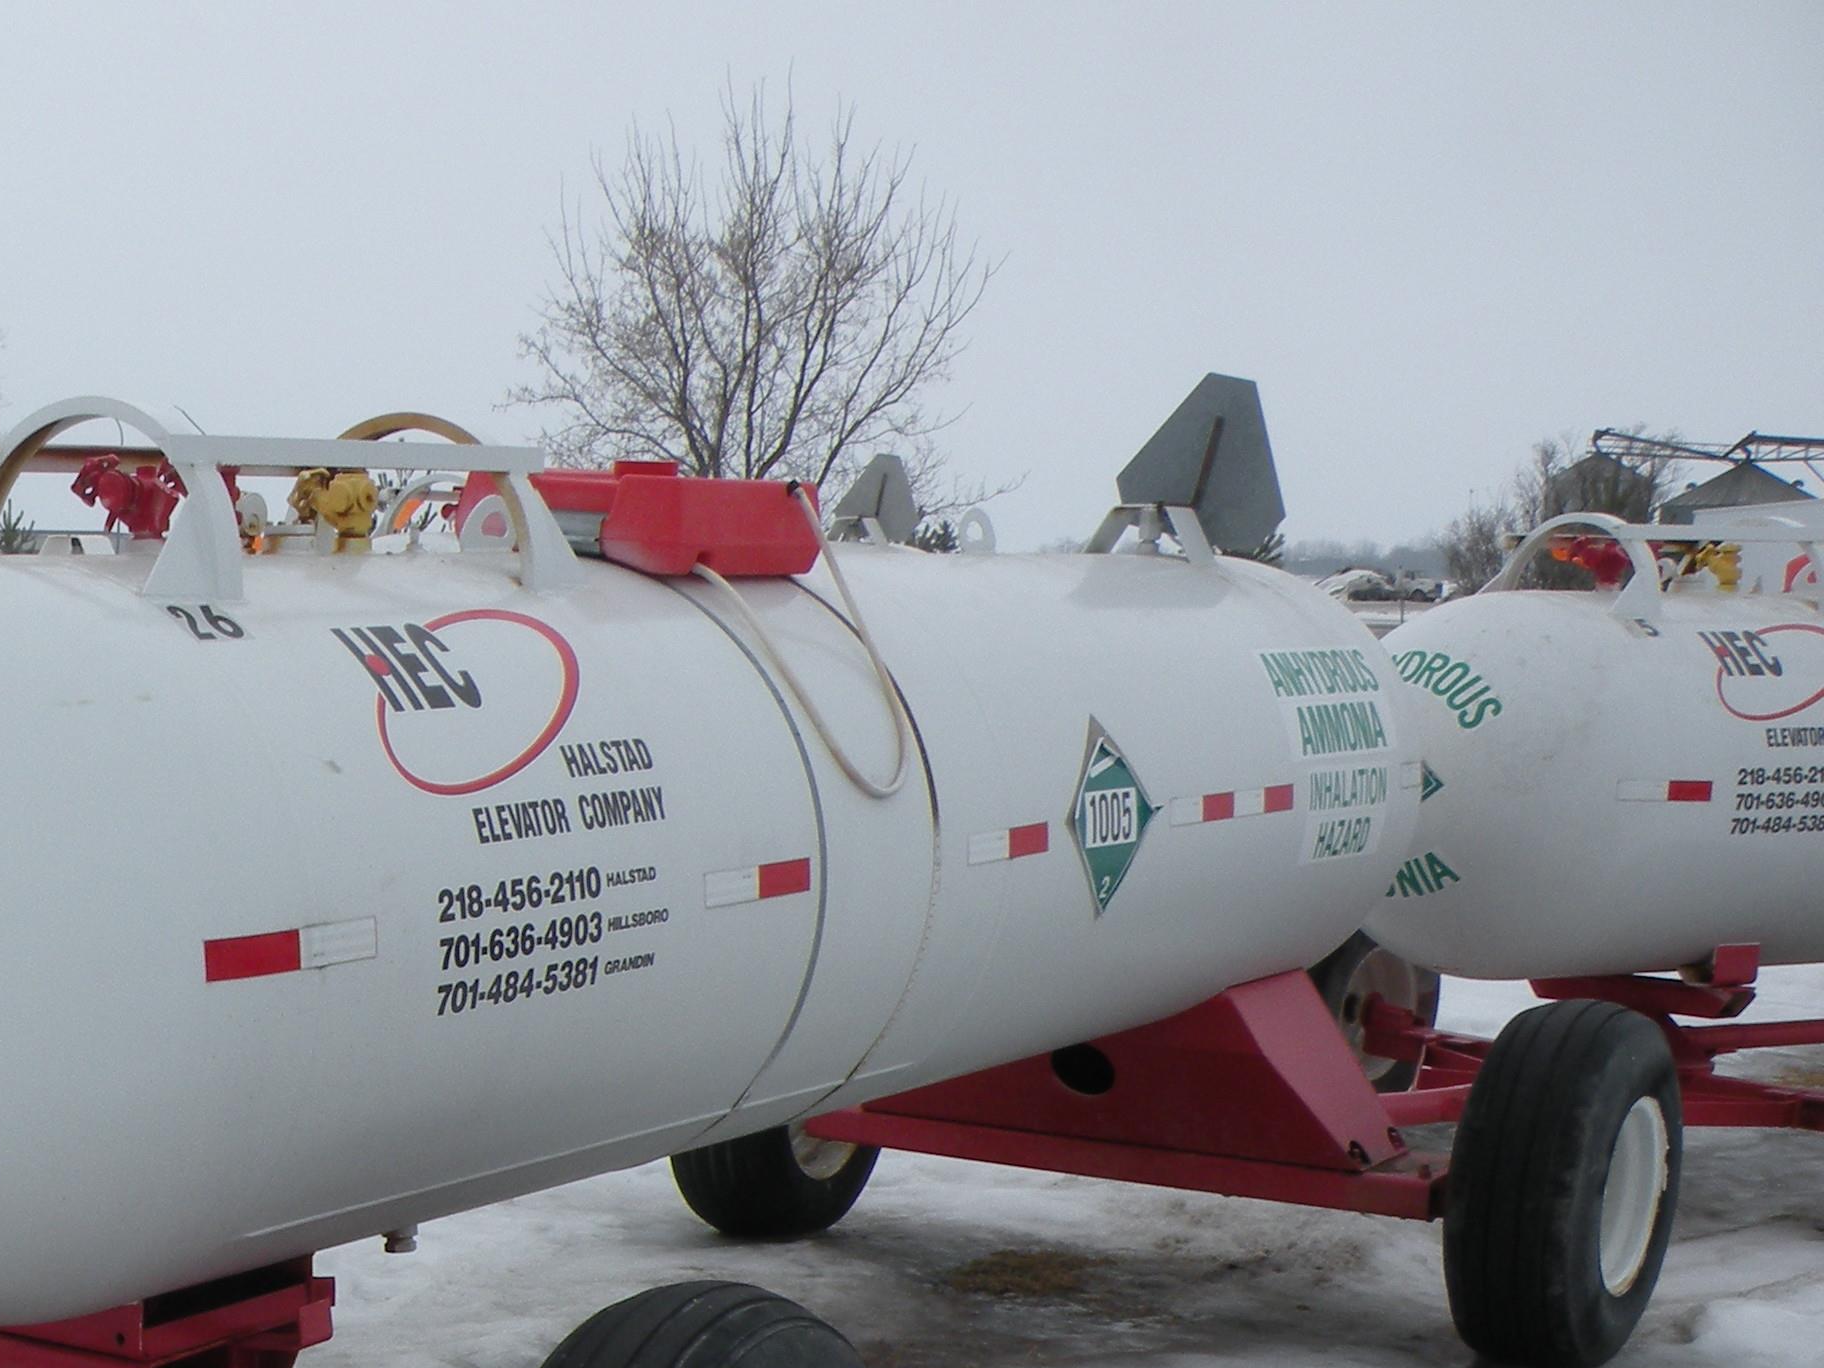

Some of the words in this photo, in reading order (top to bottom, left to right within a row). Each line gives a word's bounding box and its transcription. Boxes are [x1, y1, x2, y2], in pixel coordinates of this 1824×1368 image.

[166, 604, 245, 640] 26
[329, 622, 482, 712] HEC
[1259, 649, 1379, 697] ANHYDROUS
[1697, 630, 1783, 677] HEC
[1296, 701, 1388, 756] AMMONIA
[560, 738, 653, 778] HALSTAD
[1309, 767, 1387, 811] INHALATION
[472, 798, 571, 844] ELEVATOR
[578, 786, 666, 830] COMPANY
[1089, 791, 1132, 844] 1005
[1312, 817, 1371, 860] HAZARD
[438, 866, 602, 923] 218-456-2110
[606, 866, 657, 887] HALSTAD
[1099, 875, 1111, 898] 2
[439, 911, 603, 970] 701-636-4903
[608, 908, 669, 932] HILLSBORO
[437, 955, 599, 1016] 701-484-5381
[604, 952, 655, 975] GRANDIN
